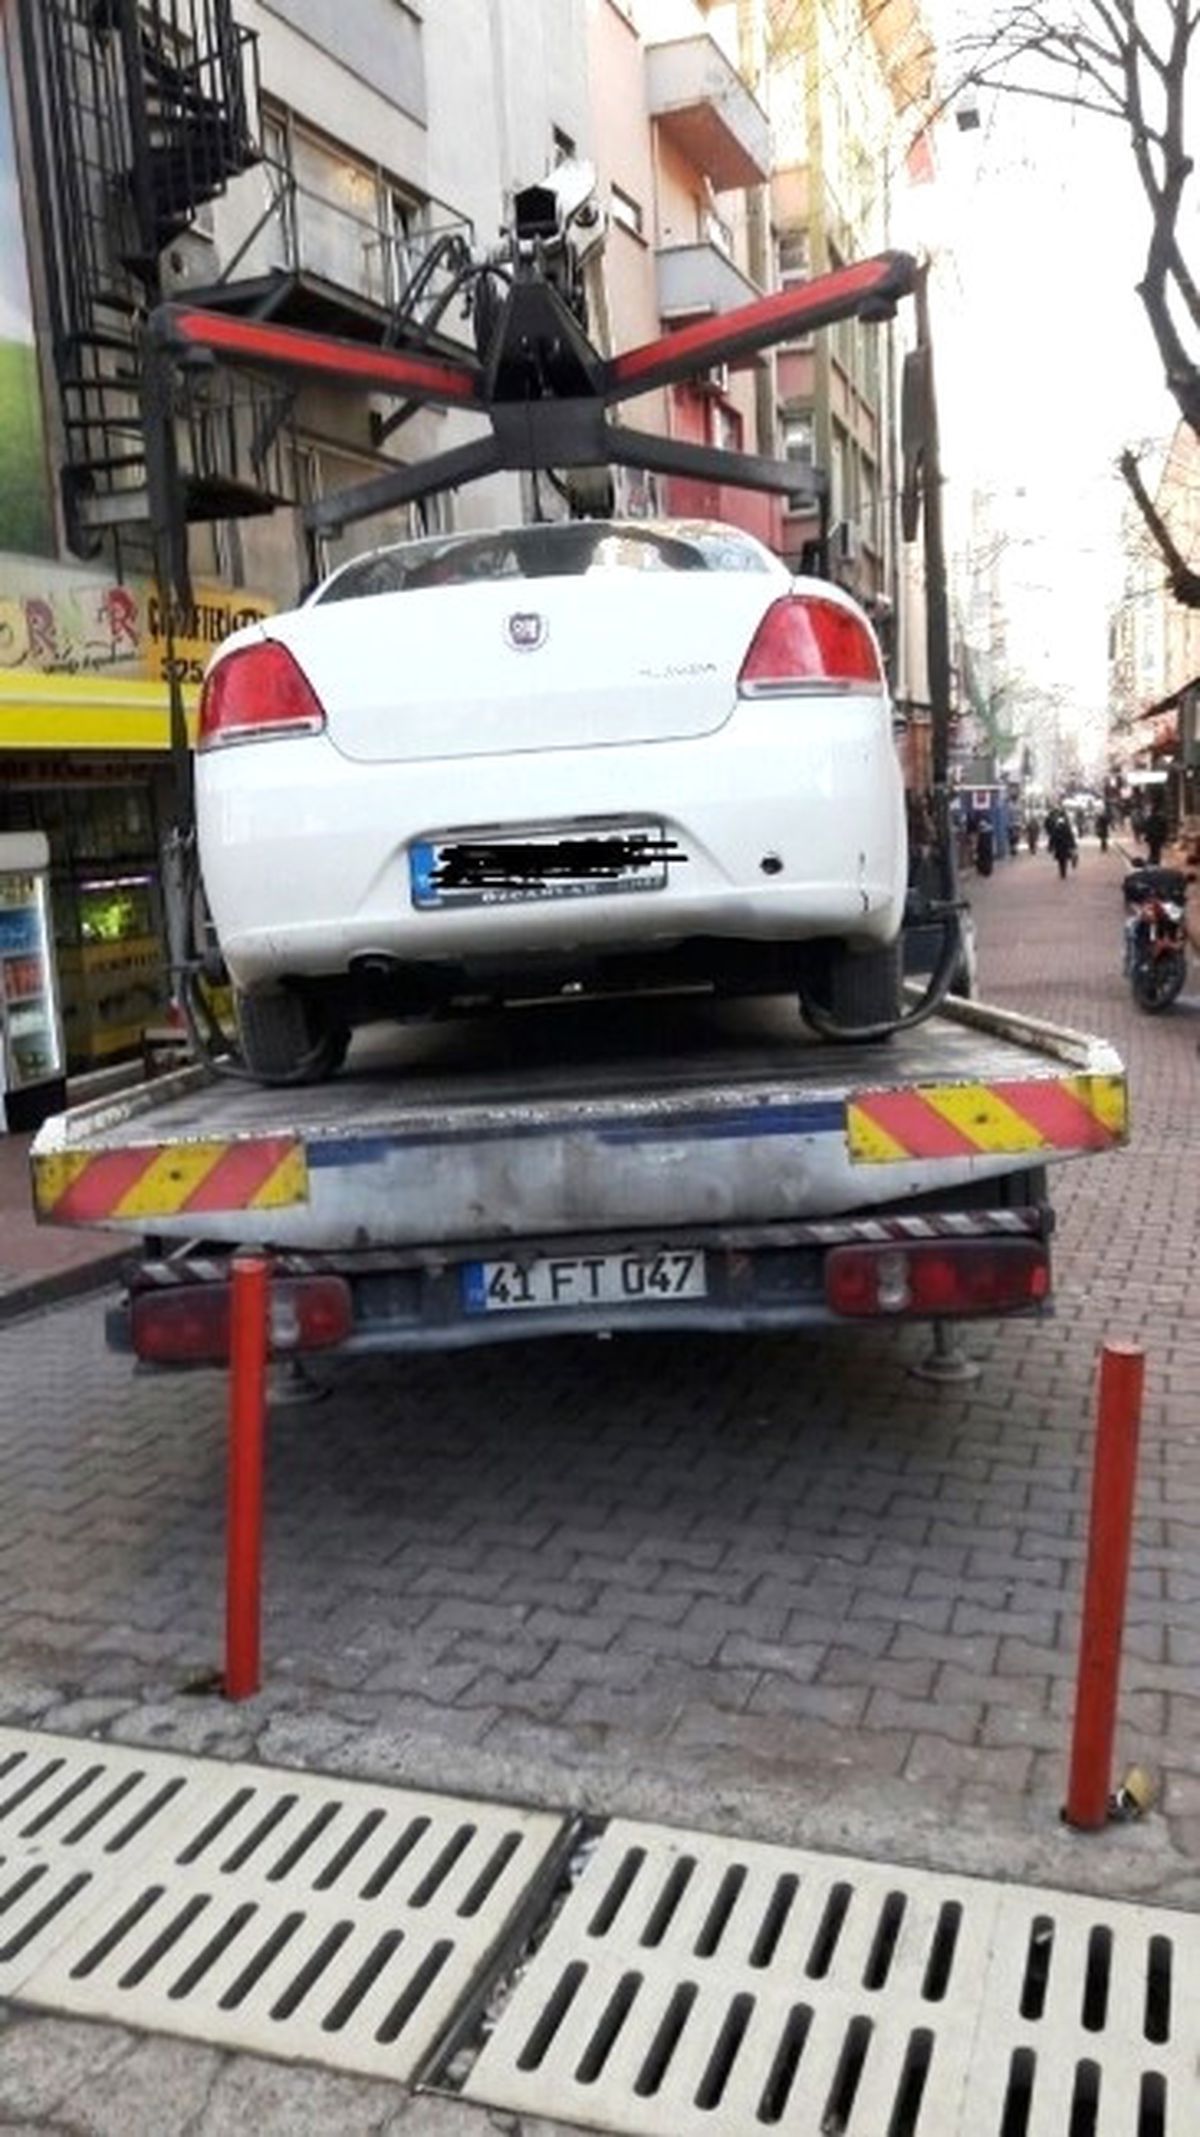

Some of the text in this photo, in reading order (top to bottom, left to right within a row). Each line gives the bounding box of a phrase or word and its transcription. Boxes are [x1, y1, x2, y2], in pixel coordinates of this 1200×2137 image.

[488, 1255, 695, 1304] 41 FT 047
